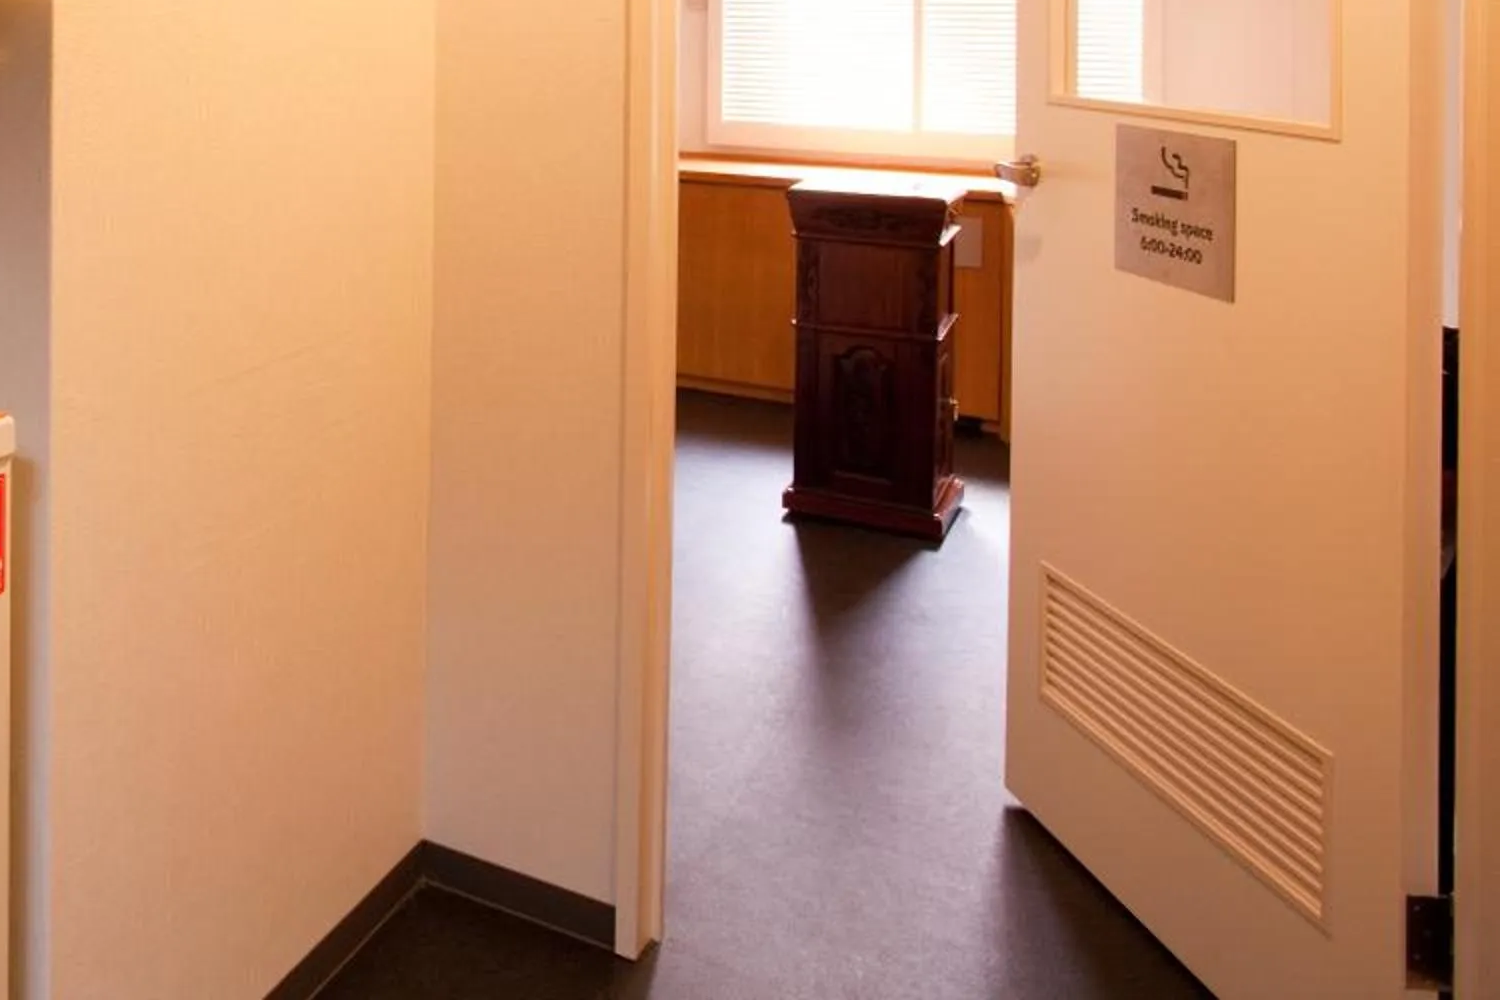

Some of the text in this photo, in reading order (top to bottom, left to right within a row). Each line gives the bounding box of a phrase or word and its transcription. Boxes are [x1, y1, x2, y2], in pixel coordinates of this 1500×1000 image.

[1131, 207, 1214, 242] Smoking space
[1140, 236, 1203, 265] 6:00-24:00
